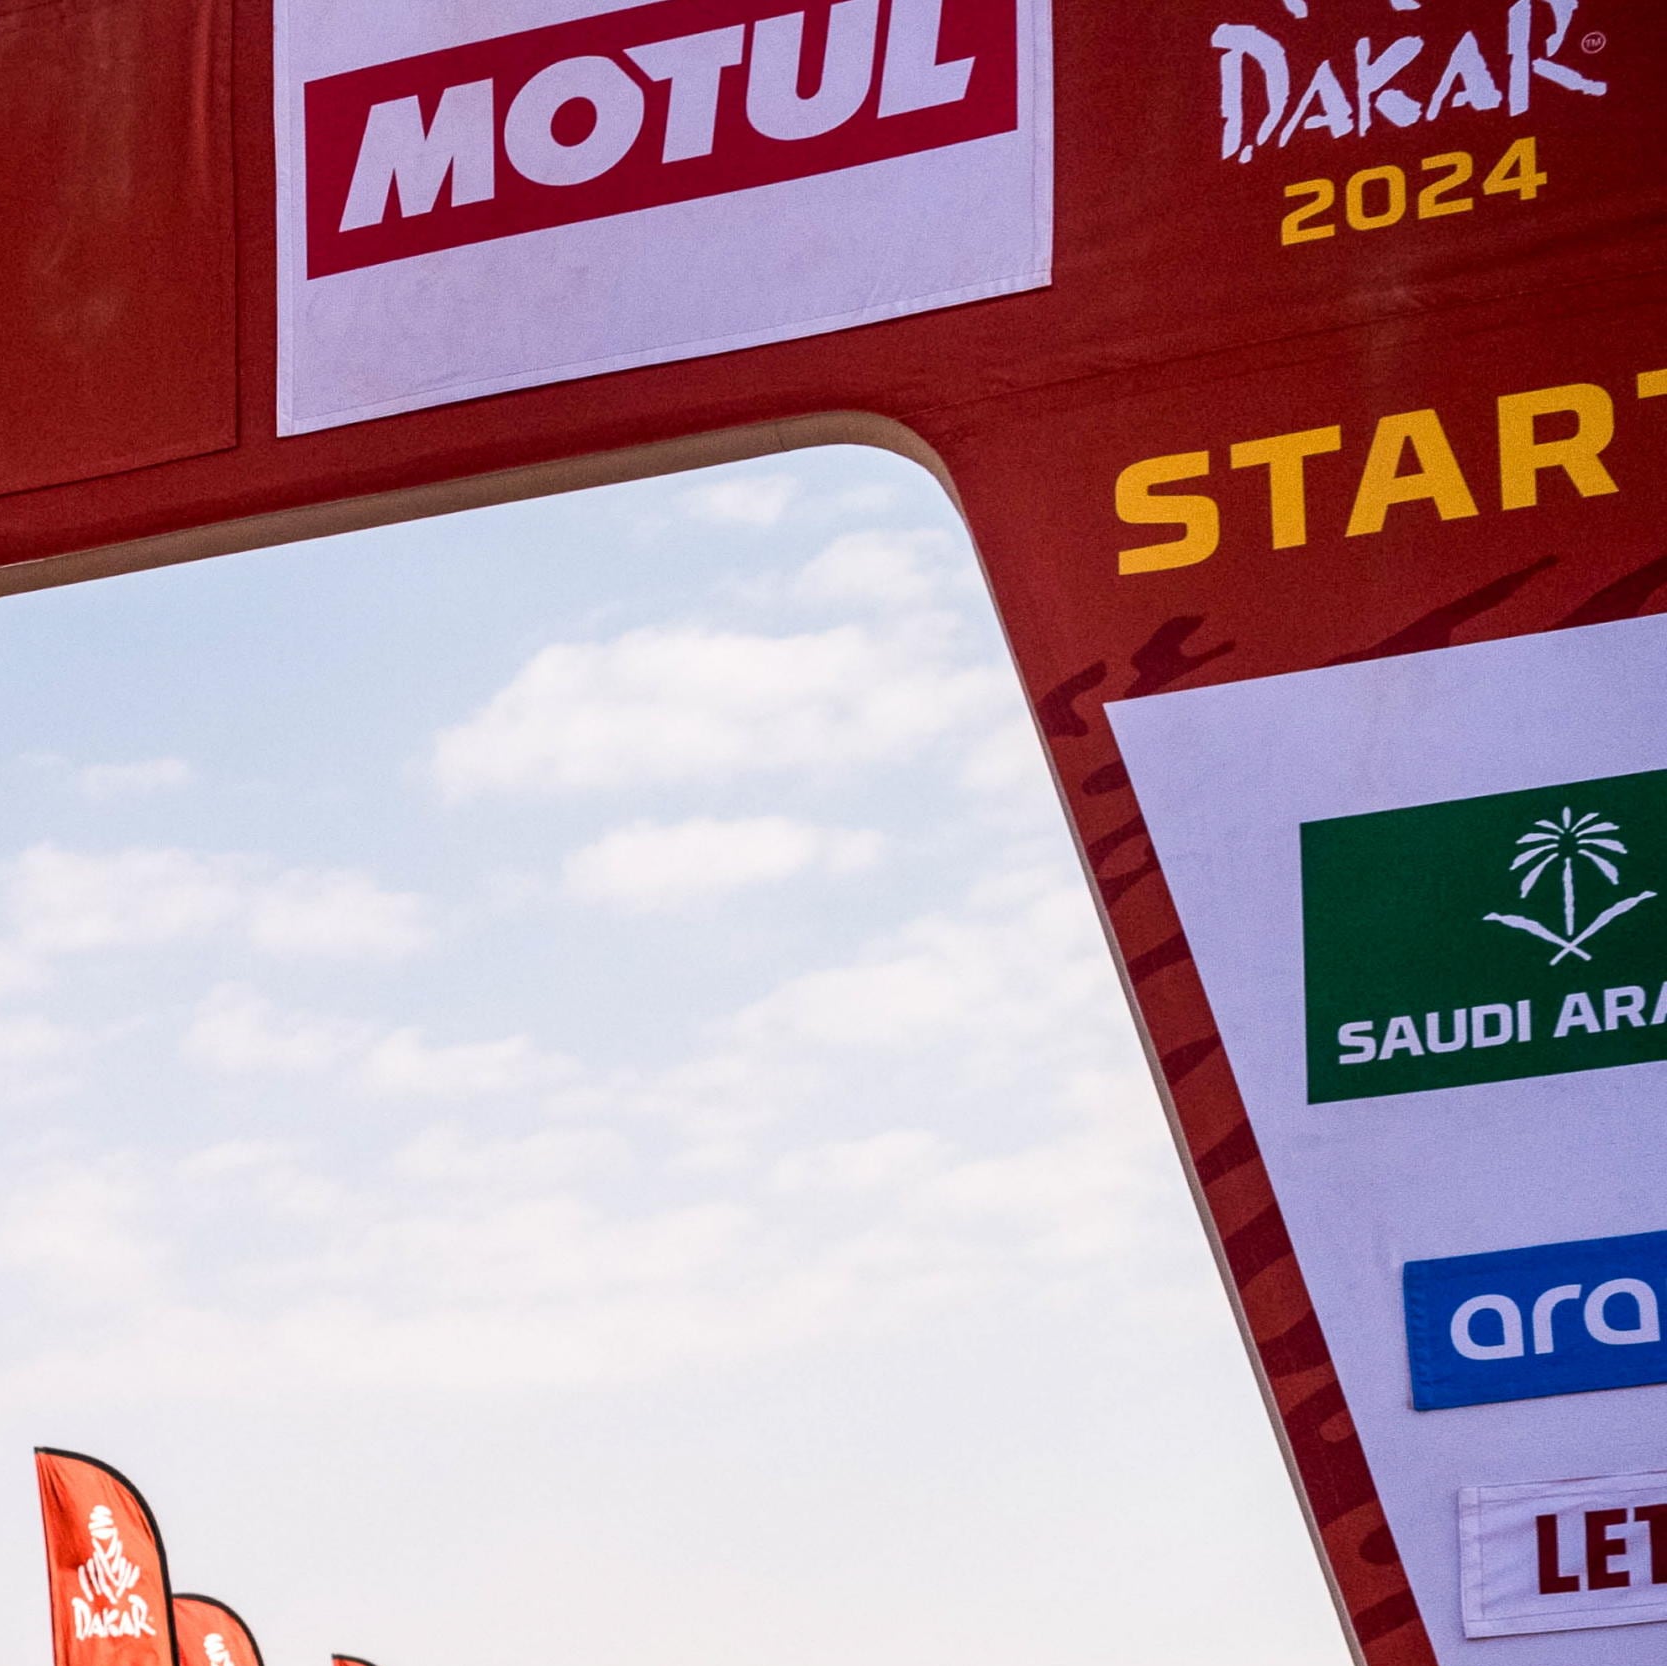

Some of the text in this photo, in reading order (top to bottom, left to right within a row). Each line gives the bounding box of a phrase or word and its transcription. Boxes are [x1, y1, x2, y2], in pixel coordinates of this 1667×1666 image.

[339, 0, 976, 233] MOTUL
[1211, 0, 1607, 163] DAKAR
[1281, 136, 1547, 246] 2024
[1115, 369, 1667, 575] STAR
[1337, 1000, 1531, 1065] SAUDI
[72, 1595, 156, 1641] DAKAR
